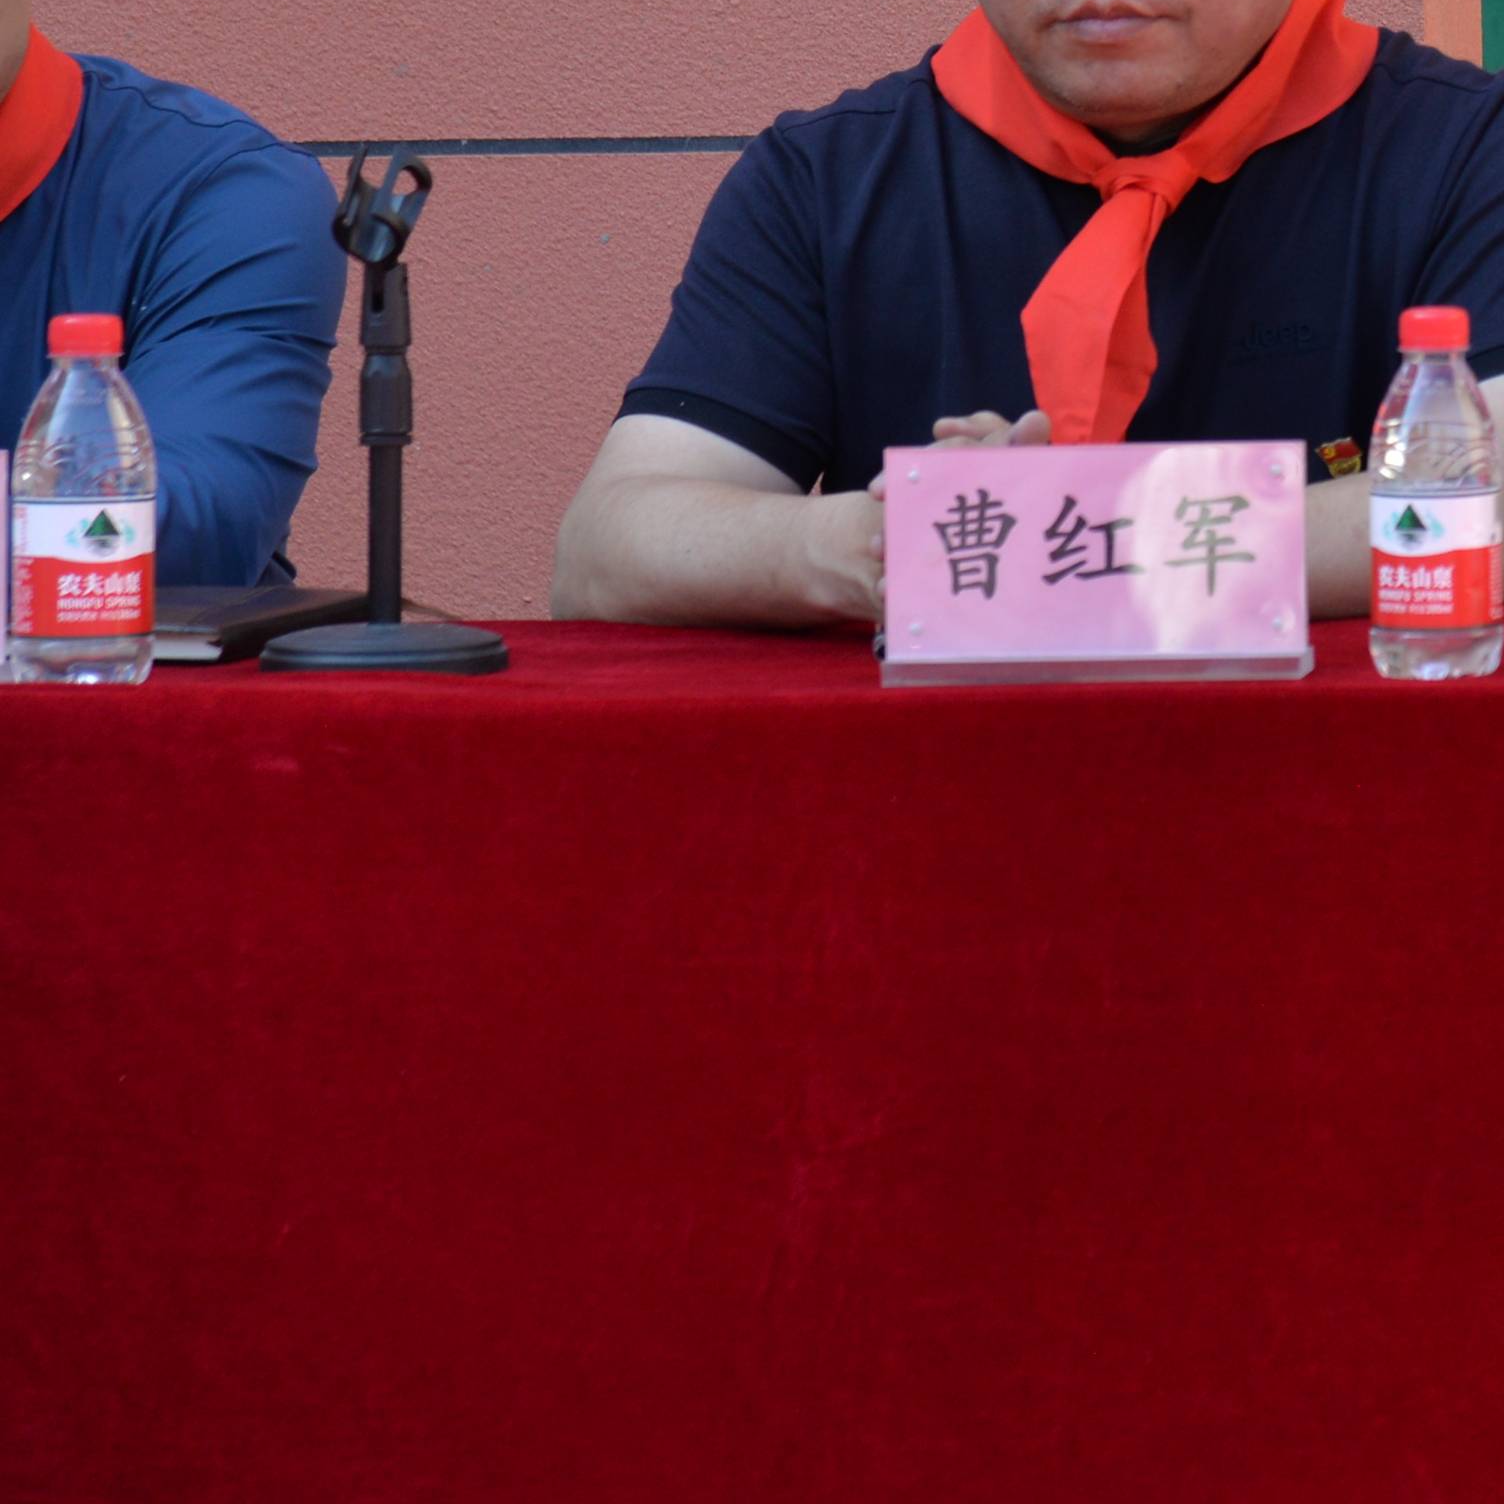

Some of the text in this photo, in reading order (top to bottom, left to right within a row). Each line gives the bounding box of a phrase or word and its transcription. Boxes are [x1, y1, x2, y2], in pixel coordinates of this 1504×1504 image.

[932, 487, 1257, 599] 曹红军
[57, 570, 142, 597] 农夫山泉
